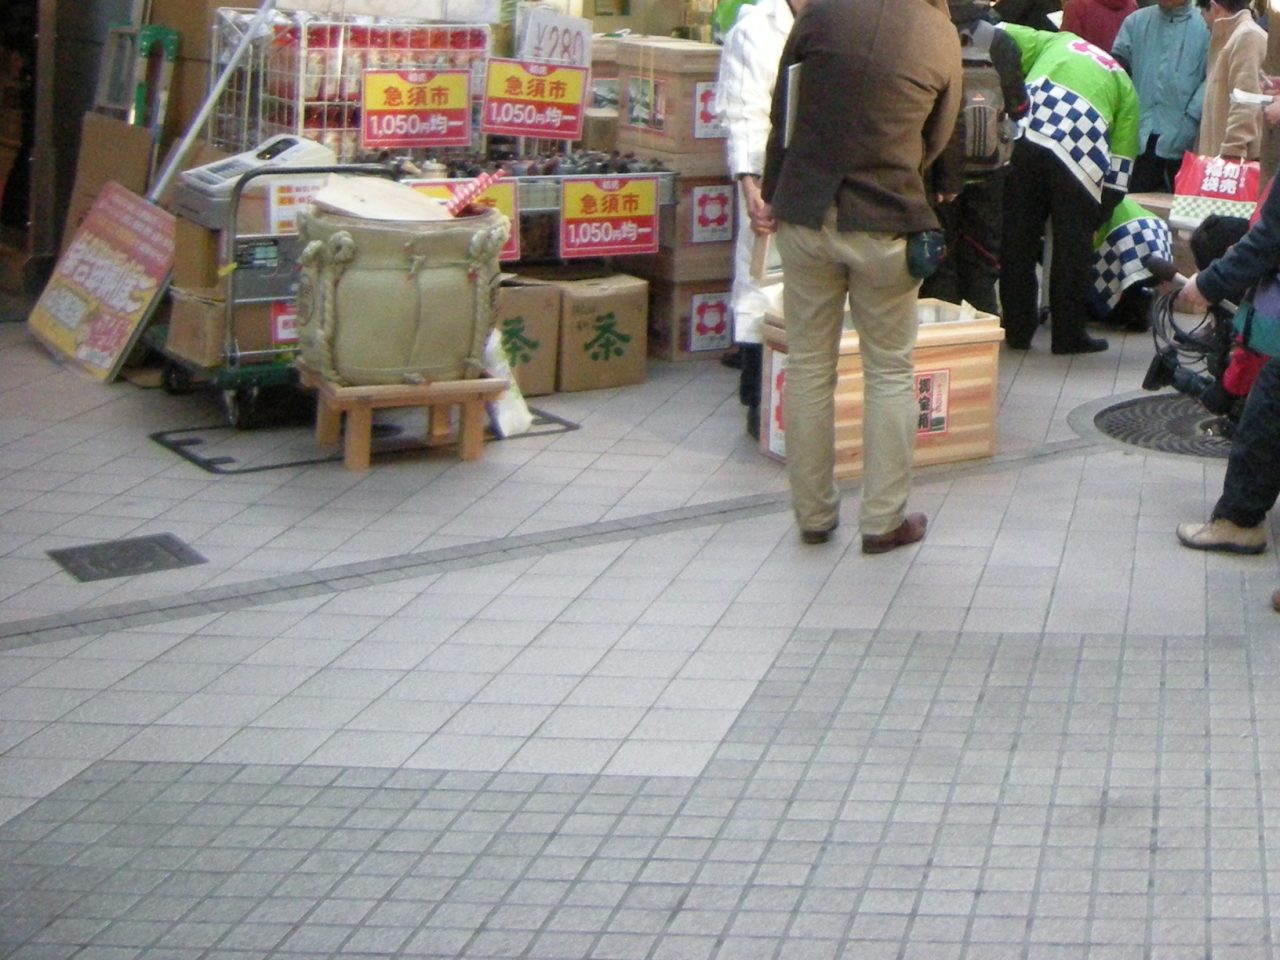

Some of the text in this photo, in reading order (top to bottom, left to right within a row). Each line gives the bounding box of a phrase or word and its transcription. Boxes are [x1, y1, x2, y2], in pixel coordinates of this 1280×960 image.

[383, 85, 450, 107] 急須市
[504, 75, 568, 100] 急須市
[579, 192, 641, 215] 急須市
